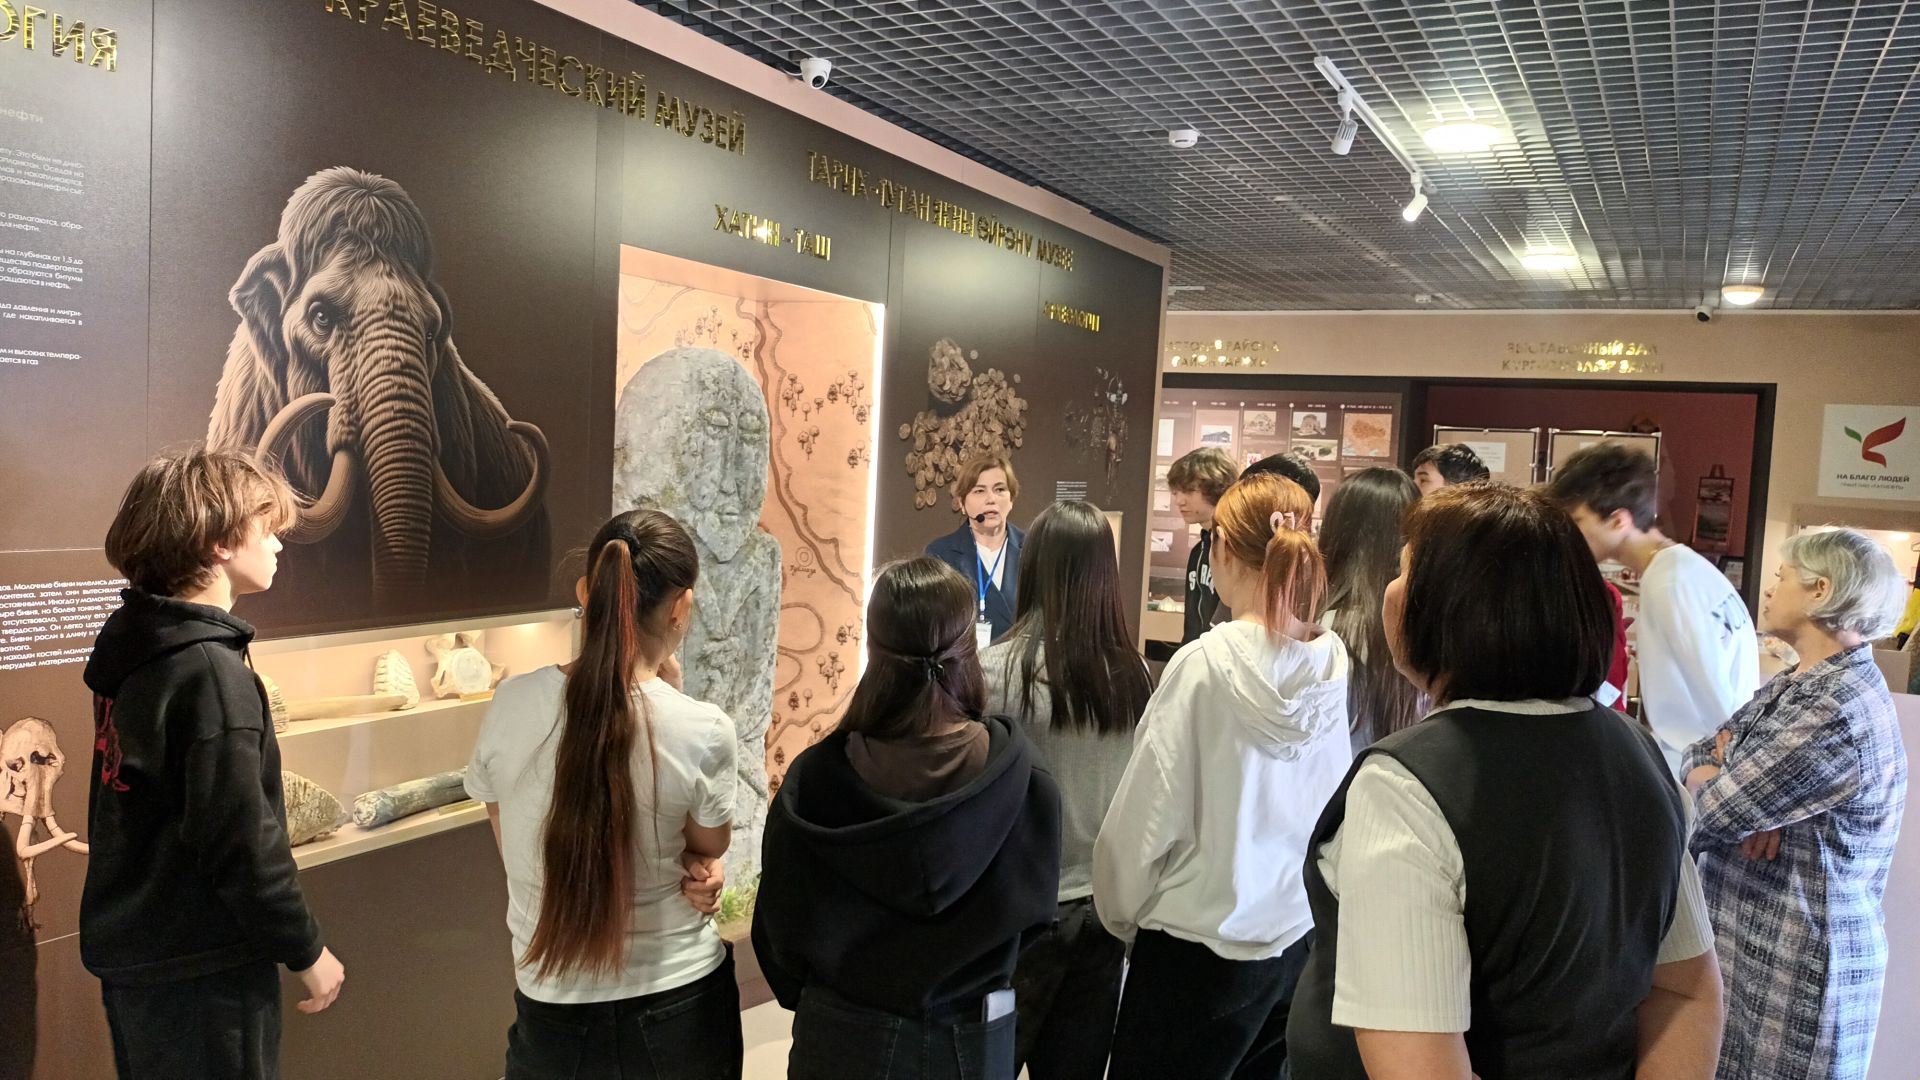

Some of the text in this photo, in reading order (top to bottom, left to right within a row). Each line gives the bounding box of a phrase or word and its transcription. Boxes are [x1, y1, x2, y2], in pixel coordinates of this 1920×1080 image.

[654, 90, 746, 156] МУЗЕЙ
[1849, 473, 1877, 481] БЛАГО
[1878, 474, 1910, 483] ЛЮДЕЙ
[63, 646, 95, 655] мамонт
